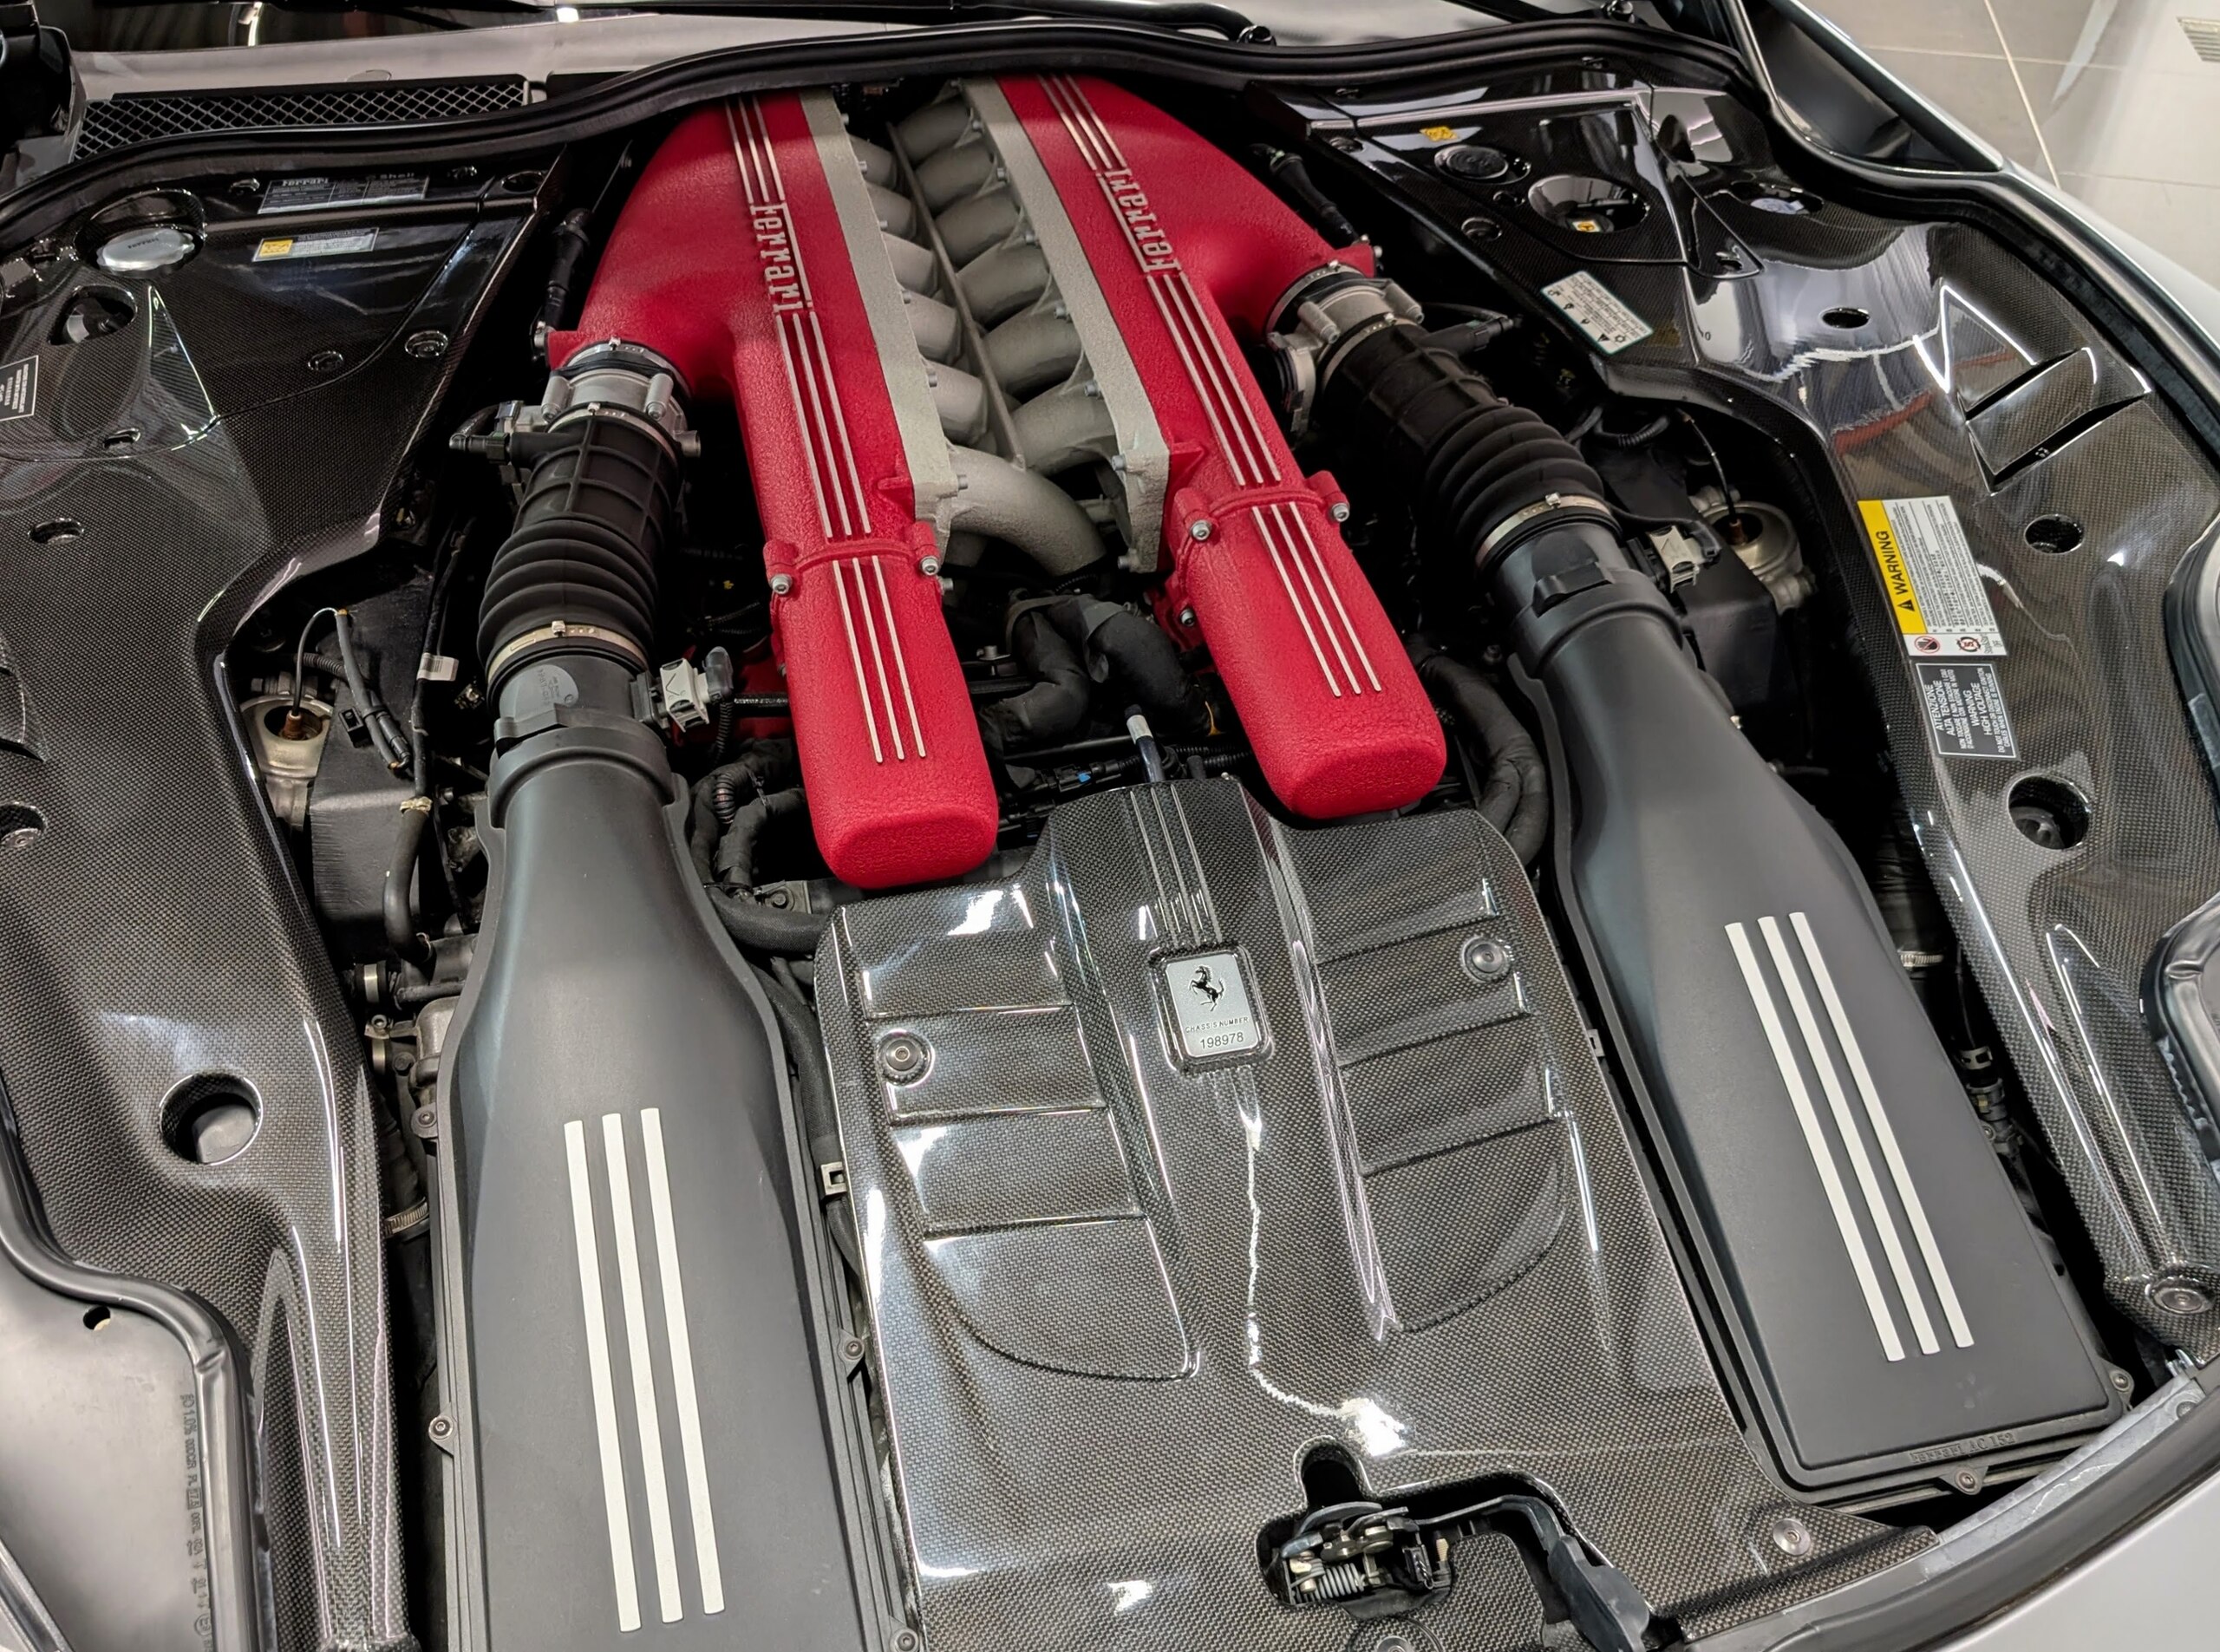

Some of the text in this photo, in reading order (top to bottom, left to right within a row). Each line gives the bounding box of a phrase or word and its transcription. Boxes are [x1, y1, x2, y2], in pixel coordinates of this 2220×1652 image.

[1095, 168, 1181, 273] Ferrari
[750, 202, 813, 313] Ferrari
[1876, 531, 1908, 595] WARNING
[1925, 684, 1944, 730] ATTENZIONE
[1933, 680, 1956, 736] ALTA TENSIONE
[1962, 689, 1980, 727] WARNING
[1970, 682, 1993, 735] HIGH VOLTAGE
[1185, 1016, 1249, 1033] CHASSIS NUMBER
[1200, 1032, 1244, 1049] 198978
[1969, 1438, 1988, 1453] AC
[1992, 1432, 2016, 1448] 152
